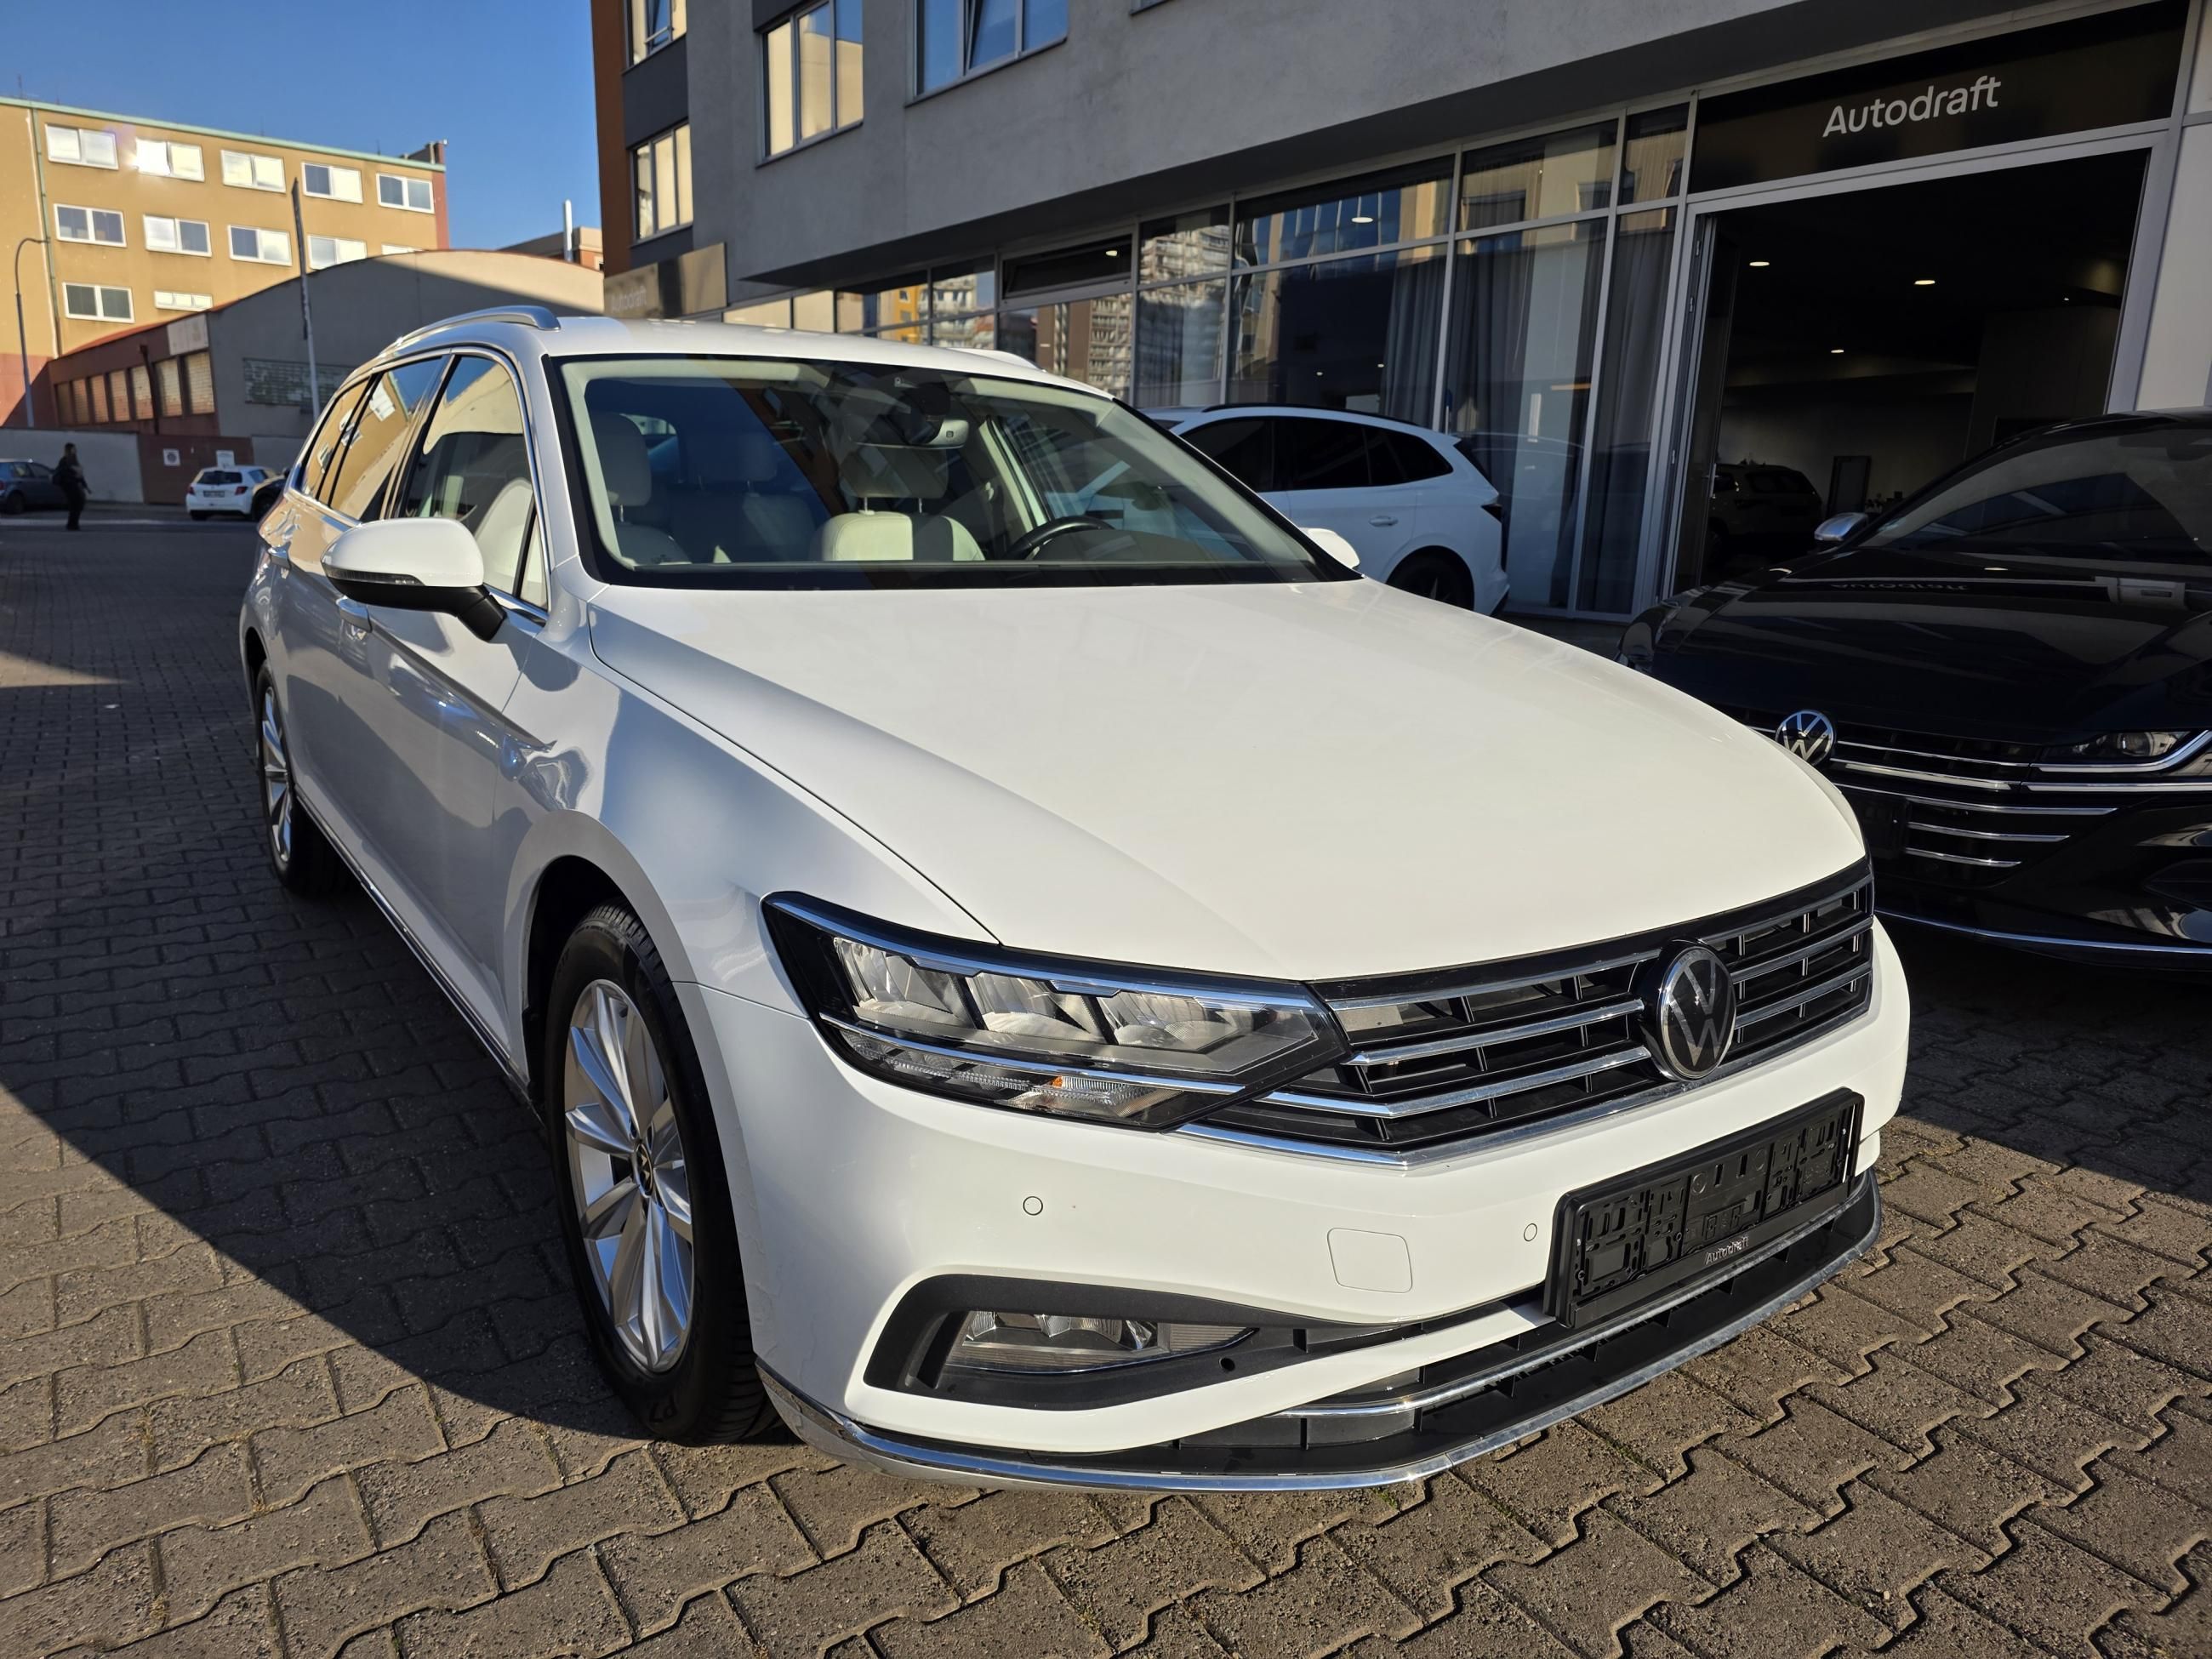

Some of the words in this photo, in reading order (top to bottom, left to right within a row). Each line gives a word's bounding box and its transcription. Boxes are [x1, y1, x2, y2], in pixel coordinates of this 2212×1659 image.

[1822, 75, 2001, 138] Autodraft
[1660, 947, 1735, 1077] VW
[1704, 1235, 1749, 1265] Autodraft
